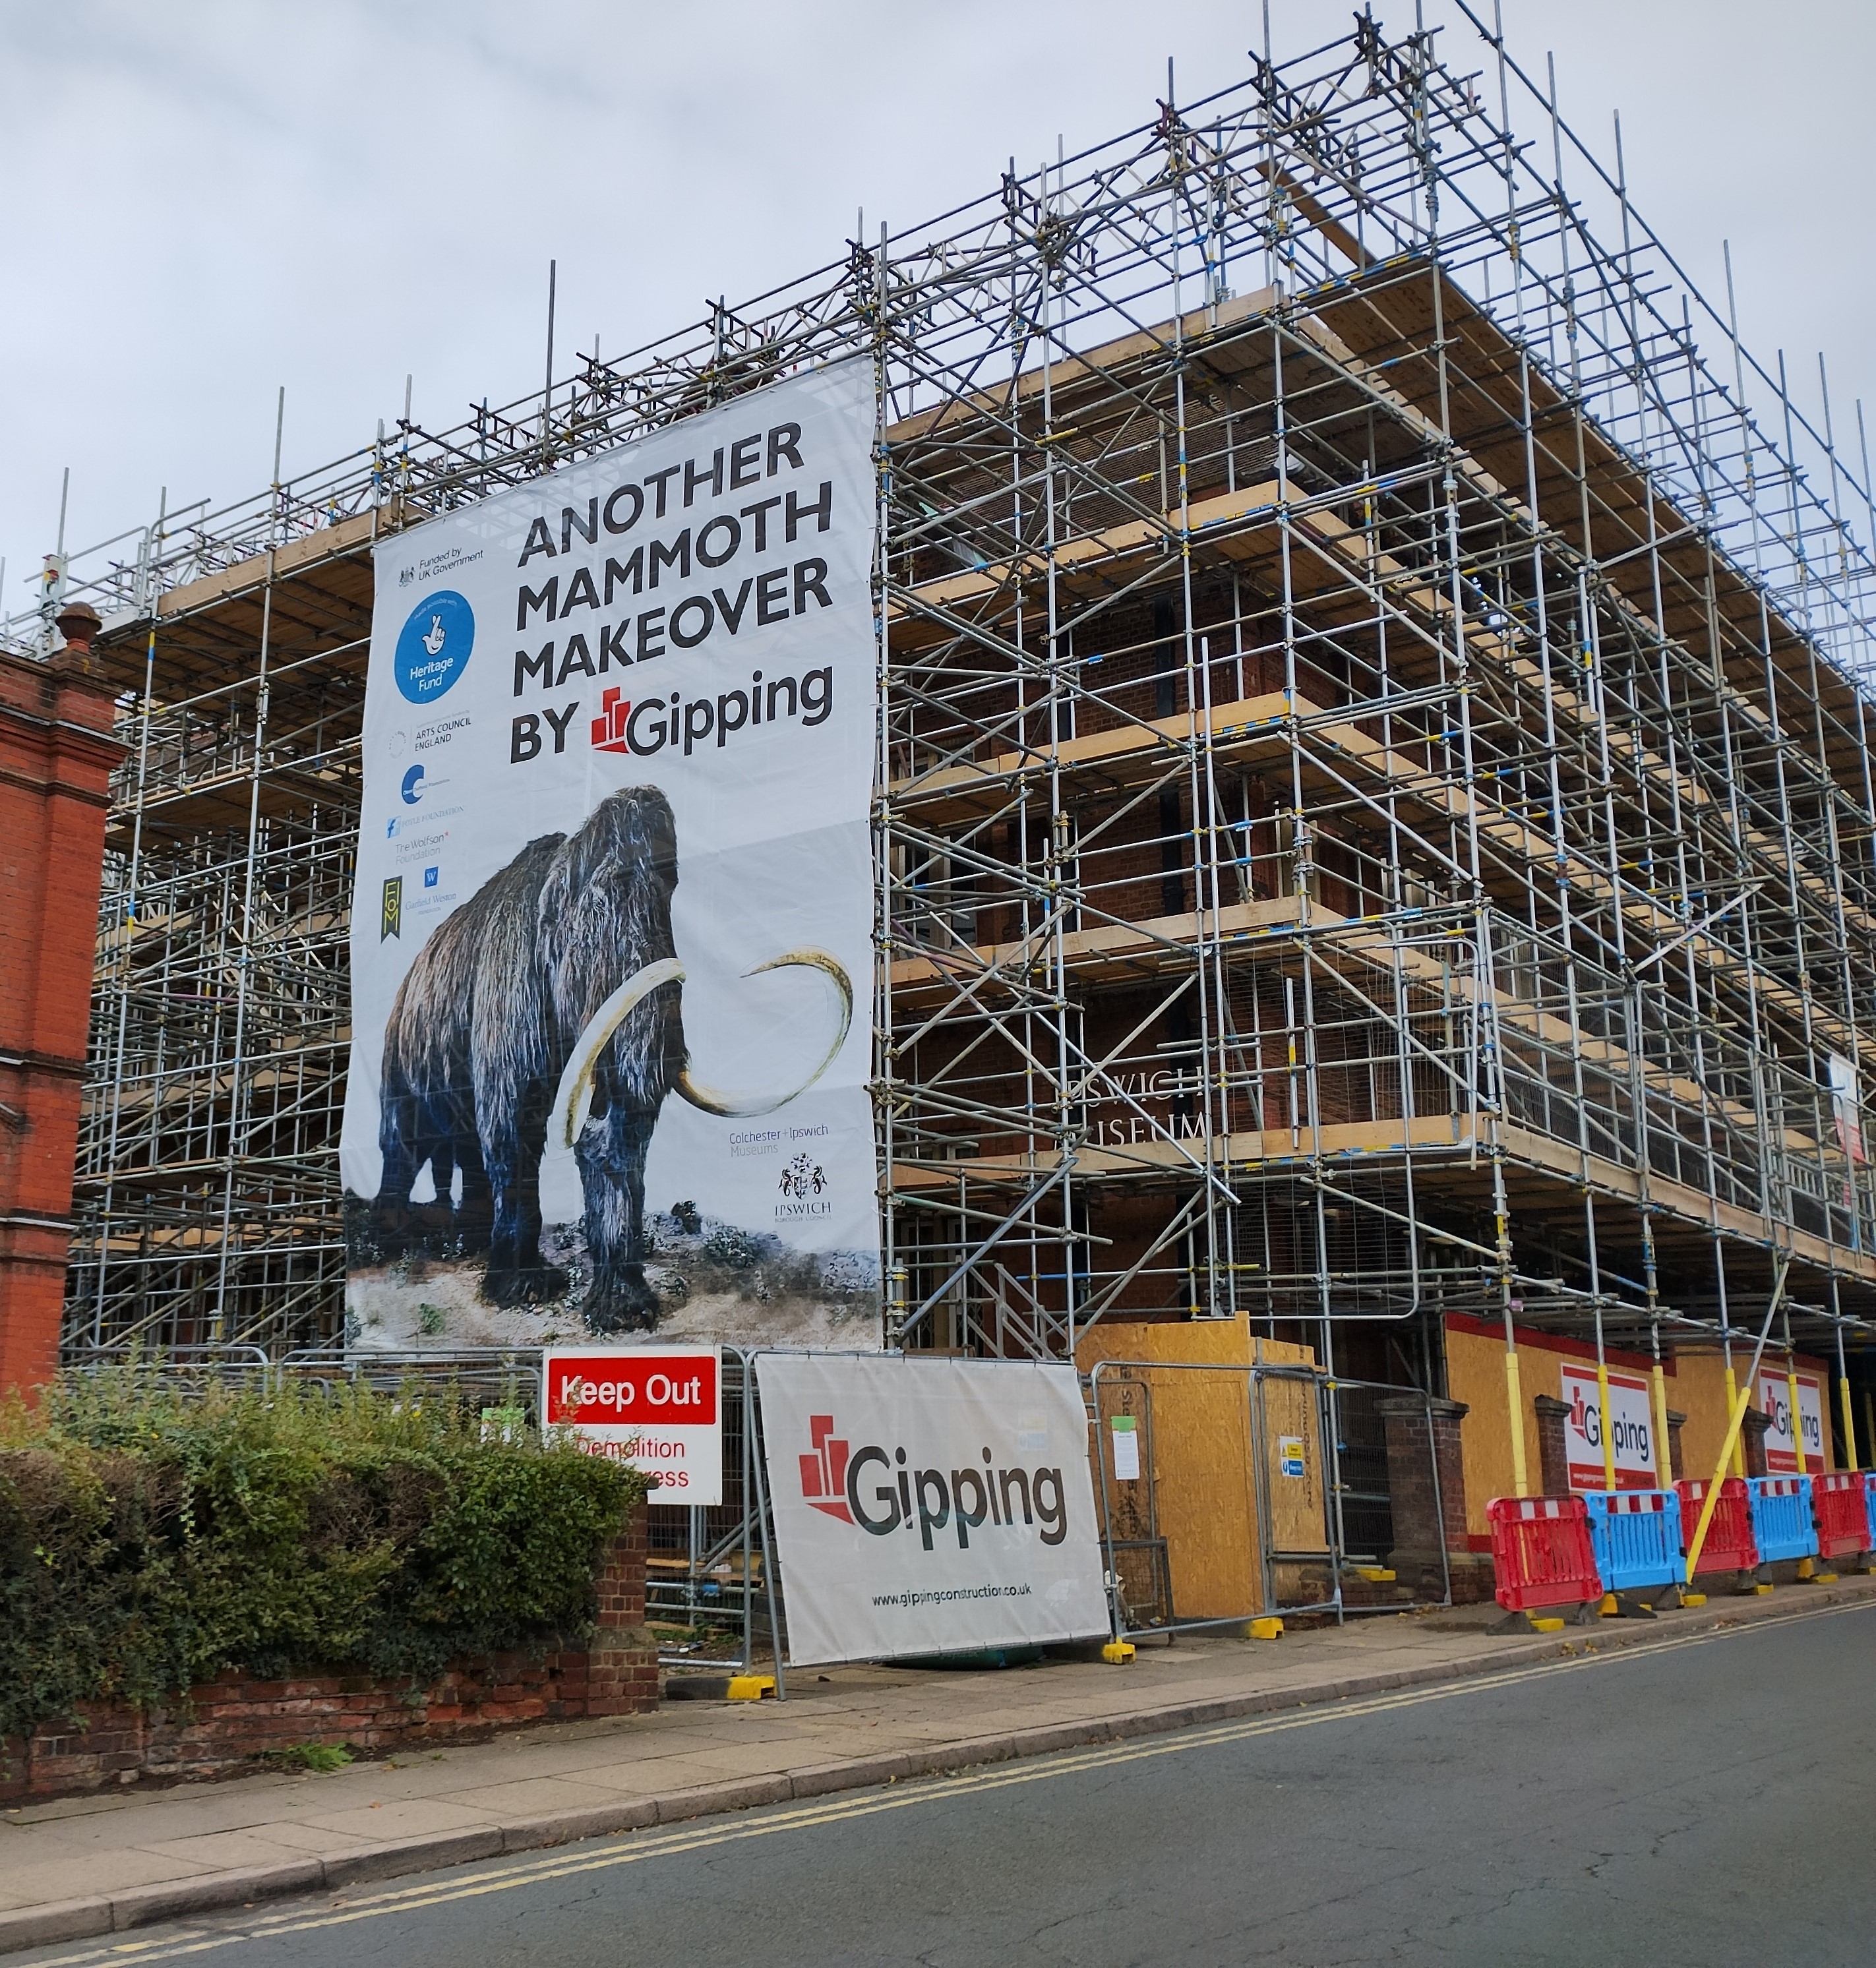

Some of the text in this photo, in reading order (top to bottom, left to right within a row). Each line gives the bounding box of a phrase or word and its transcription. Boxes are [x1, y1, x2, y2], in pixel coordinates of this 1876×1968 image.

[518, 422, 804, 568] ANOTHER
[419, 547, 462, 569] Funded by
[419, 550, 484, 581] UK Government
[516, 481, 832, 631] MAMMOTH
[513, 557, 833, 697] MAKEOVER
[410, 657, 454, 680] Heritage
[419, 674, 442, 692] Fund
[510, 666, 833, 764] BY Gipping
[415, 727, 435, 740] ARTS
[437, 717, 471, 733] COUNCIL
[415, 734, 452, 751] ENGLAND
[411, 835, 444, 850] Wolfson
[396, 847, 440, 865] Foundation
[731, 1144, 778, 1157] Museums
[775, 1202, 831, 1216] IPSWICH
[561, 1374, 701, 1412] Keep Out
[1585, 1405, 1649, 1462] Giping
[847, 1445, 1068, 1551] Gipping
